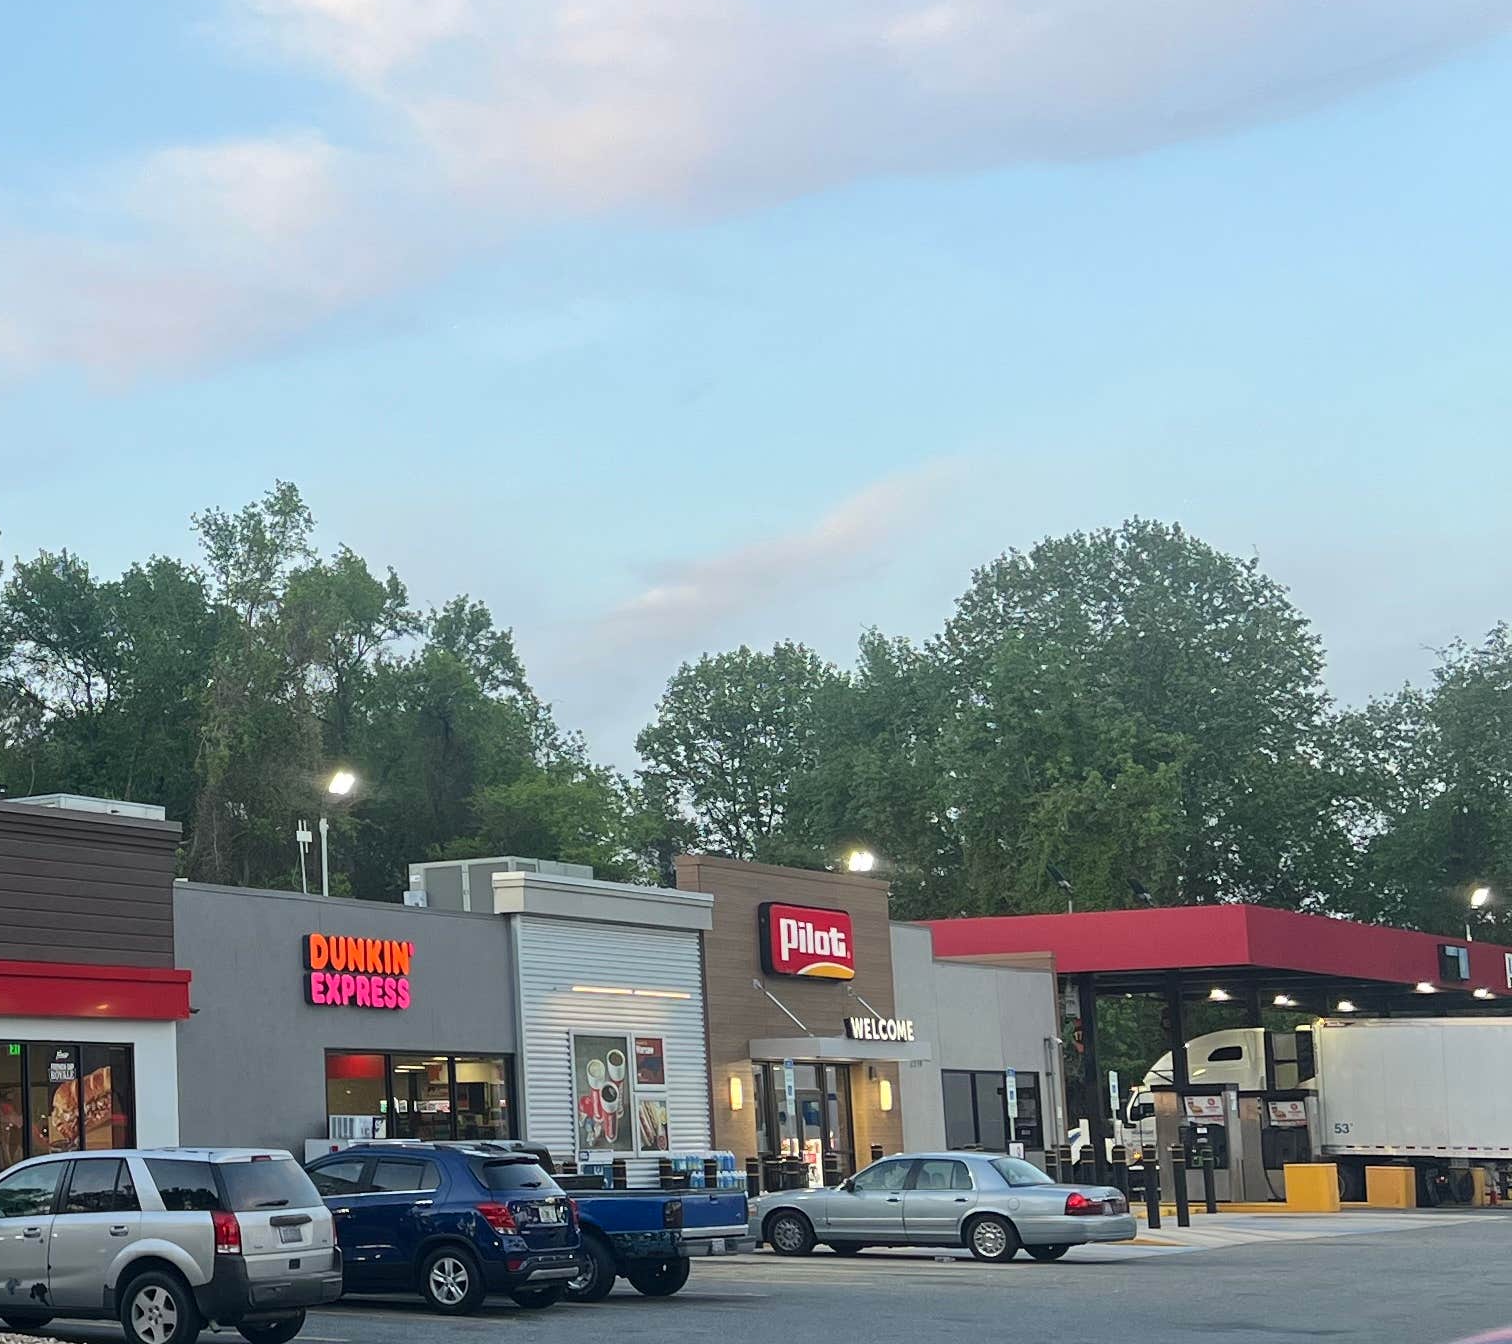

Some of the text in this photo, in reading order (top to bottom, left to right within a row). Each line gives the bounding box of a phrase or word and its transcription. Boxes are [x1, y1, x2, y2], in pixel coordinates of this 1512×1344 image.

[309, 933, 415, 976] DUNKIN'
[779, 918, 847, 961] Pilot
[311, 971, 410, 1009] EXPRESS
[850, 1016, 915, 1042] WELCOME
